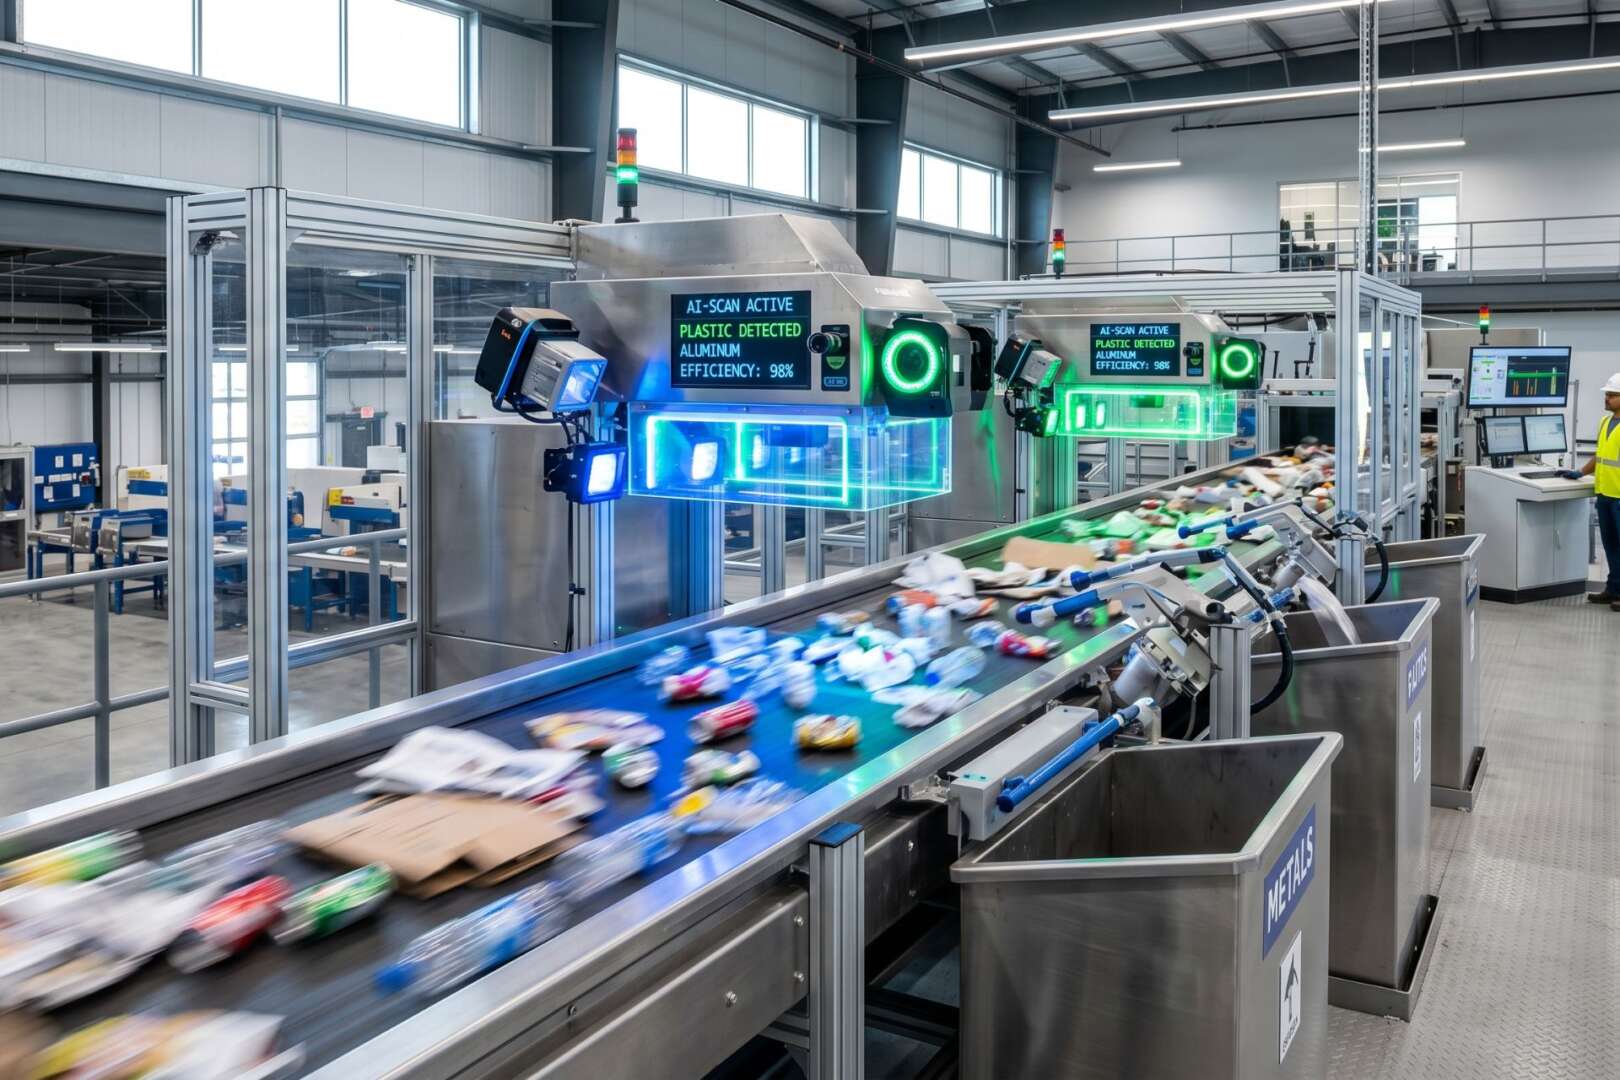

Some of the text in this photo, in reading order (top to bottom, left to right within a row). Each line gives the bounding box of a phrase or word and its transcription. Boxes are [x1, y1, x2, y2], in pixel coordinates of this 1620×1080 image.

[687, 297, 793, 314] AI-SCAN ACTIVE
[680, 322, 801, 338] PLASTIC DETECTED
[1100, 325, 1169, 335] AI-SCAN ACTIVE
[680, 343, 740, 357] ALUMINUM
[1095, 339, 1175, 349] PLASTIC DETECTED
[1096, 350, 1136, 359] ALUMINUM
[680, 363, 794, 378] EFFICIENCY: 98%
[1096, 361, 1170, 370] EFFICIENCY: 98%
[1267, 825, 1314, 934] METALS
